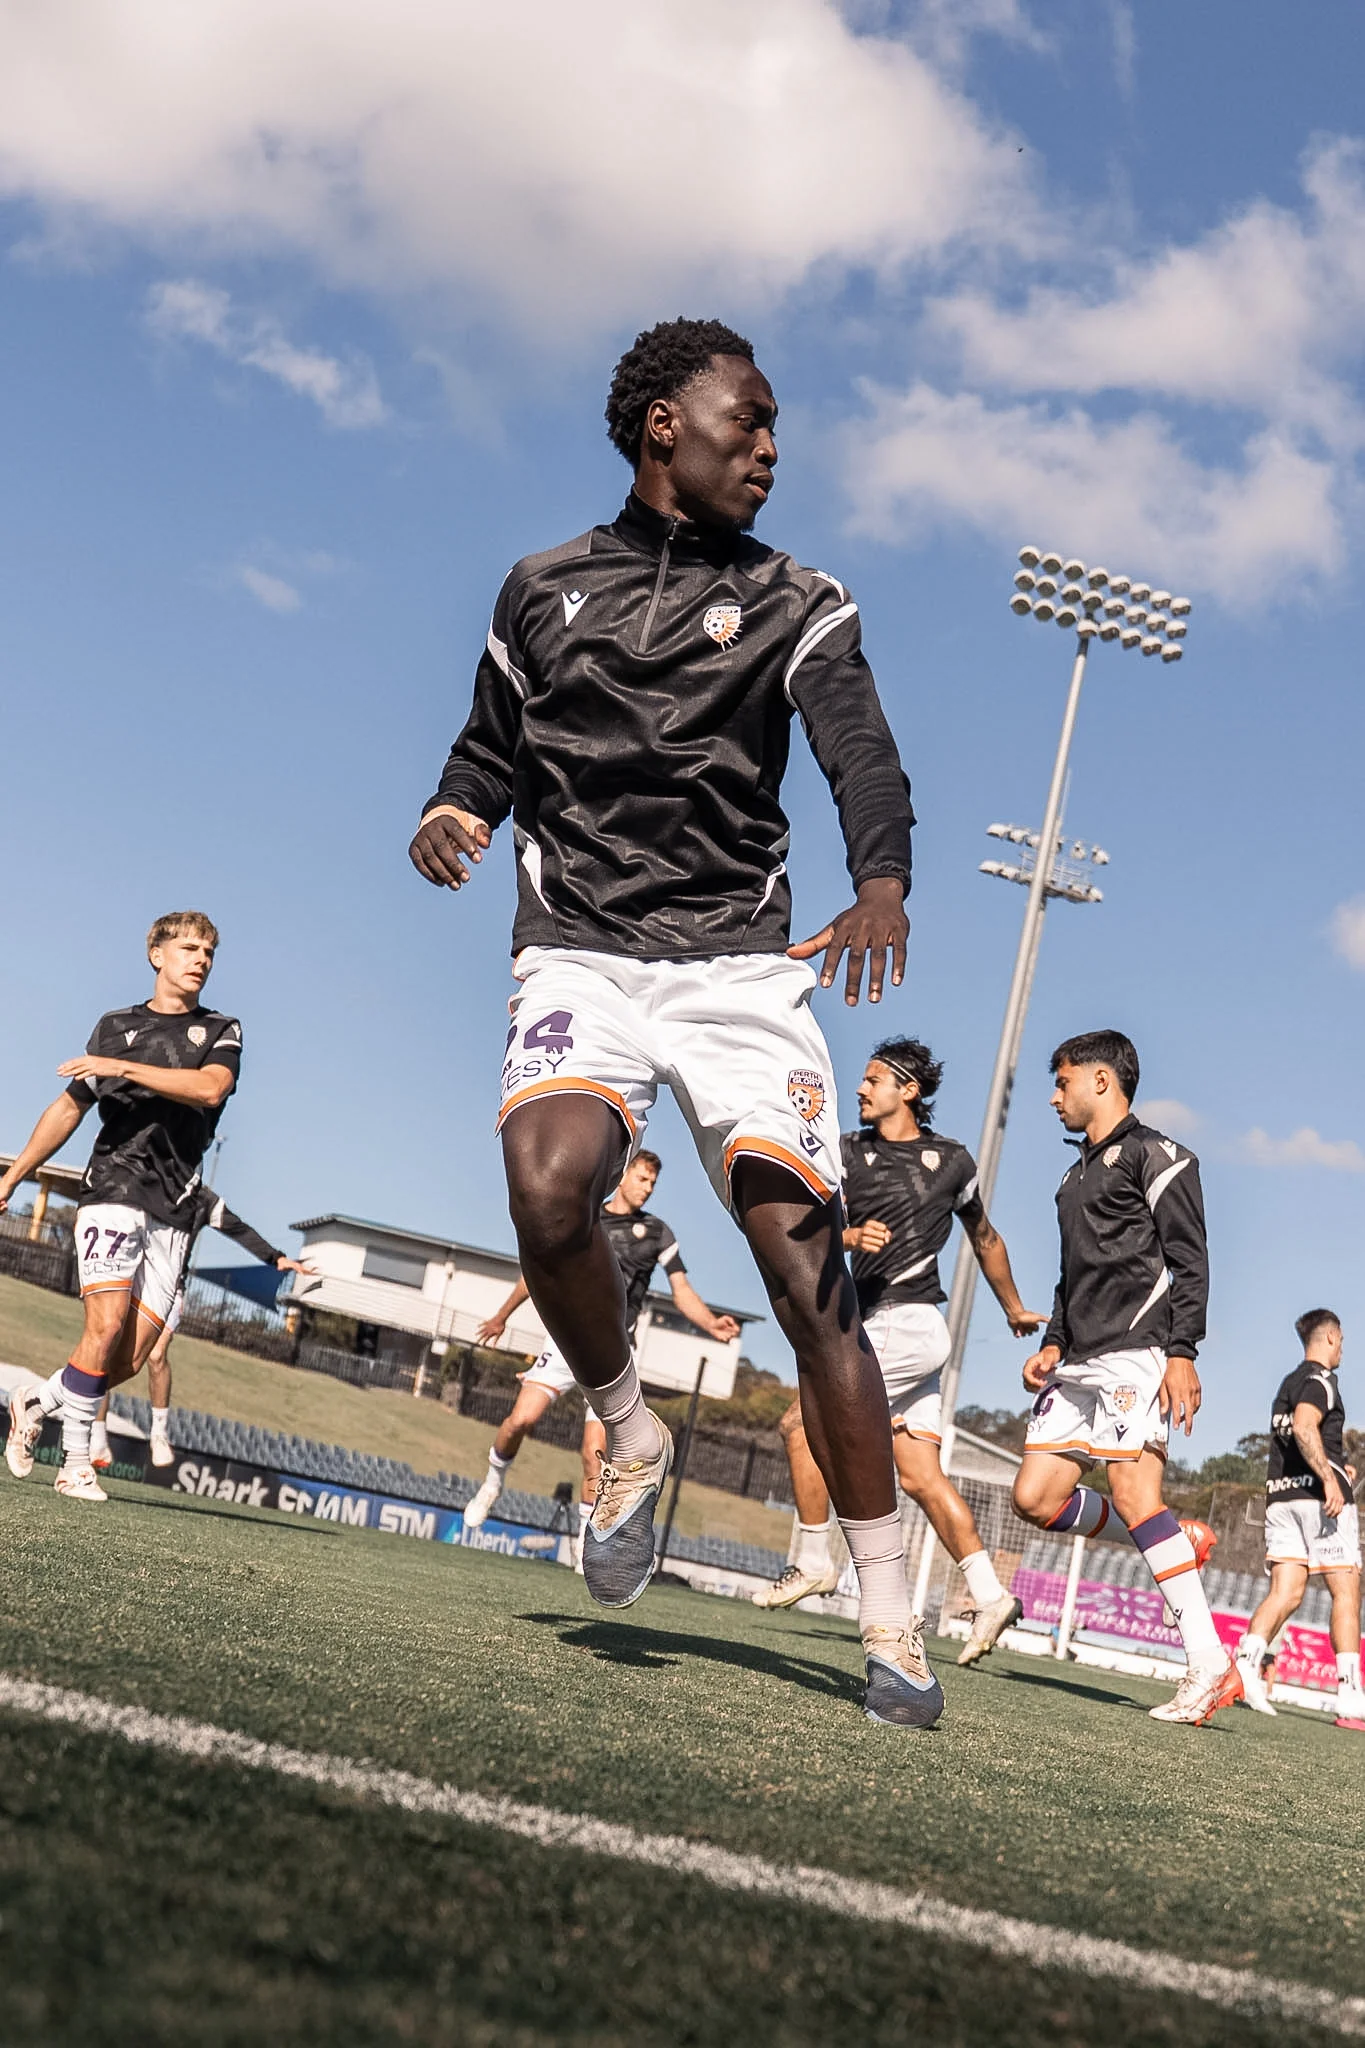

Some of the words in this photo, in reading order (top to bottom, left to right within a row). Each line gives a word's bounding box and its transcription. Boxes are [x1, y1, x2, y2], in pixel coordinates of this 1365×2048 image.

[792, 1077, 822, 1089] GLORY
[793, 1071, 820, 1080] PERTH
[84, 1226, 128, 1261] 27
[172, 1461, 269, 1508] Shark
[378, 1503, 436, 1541] STM
